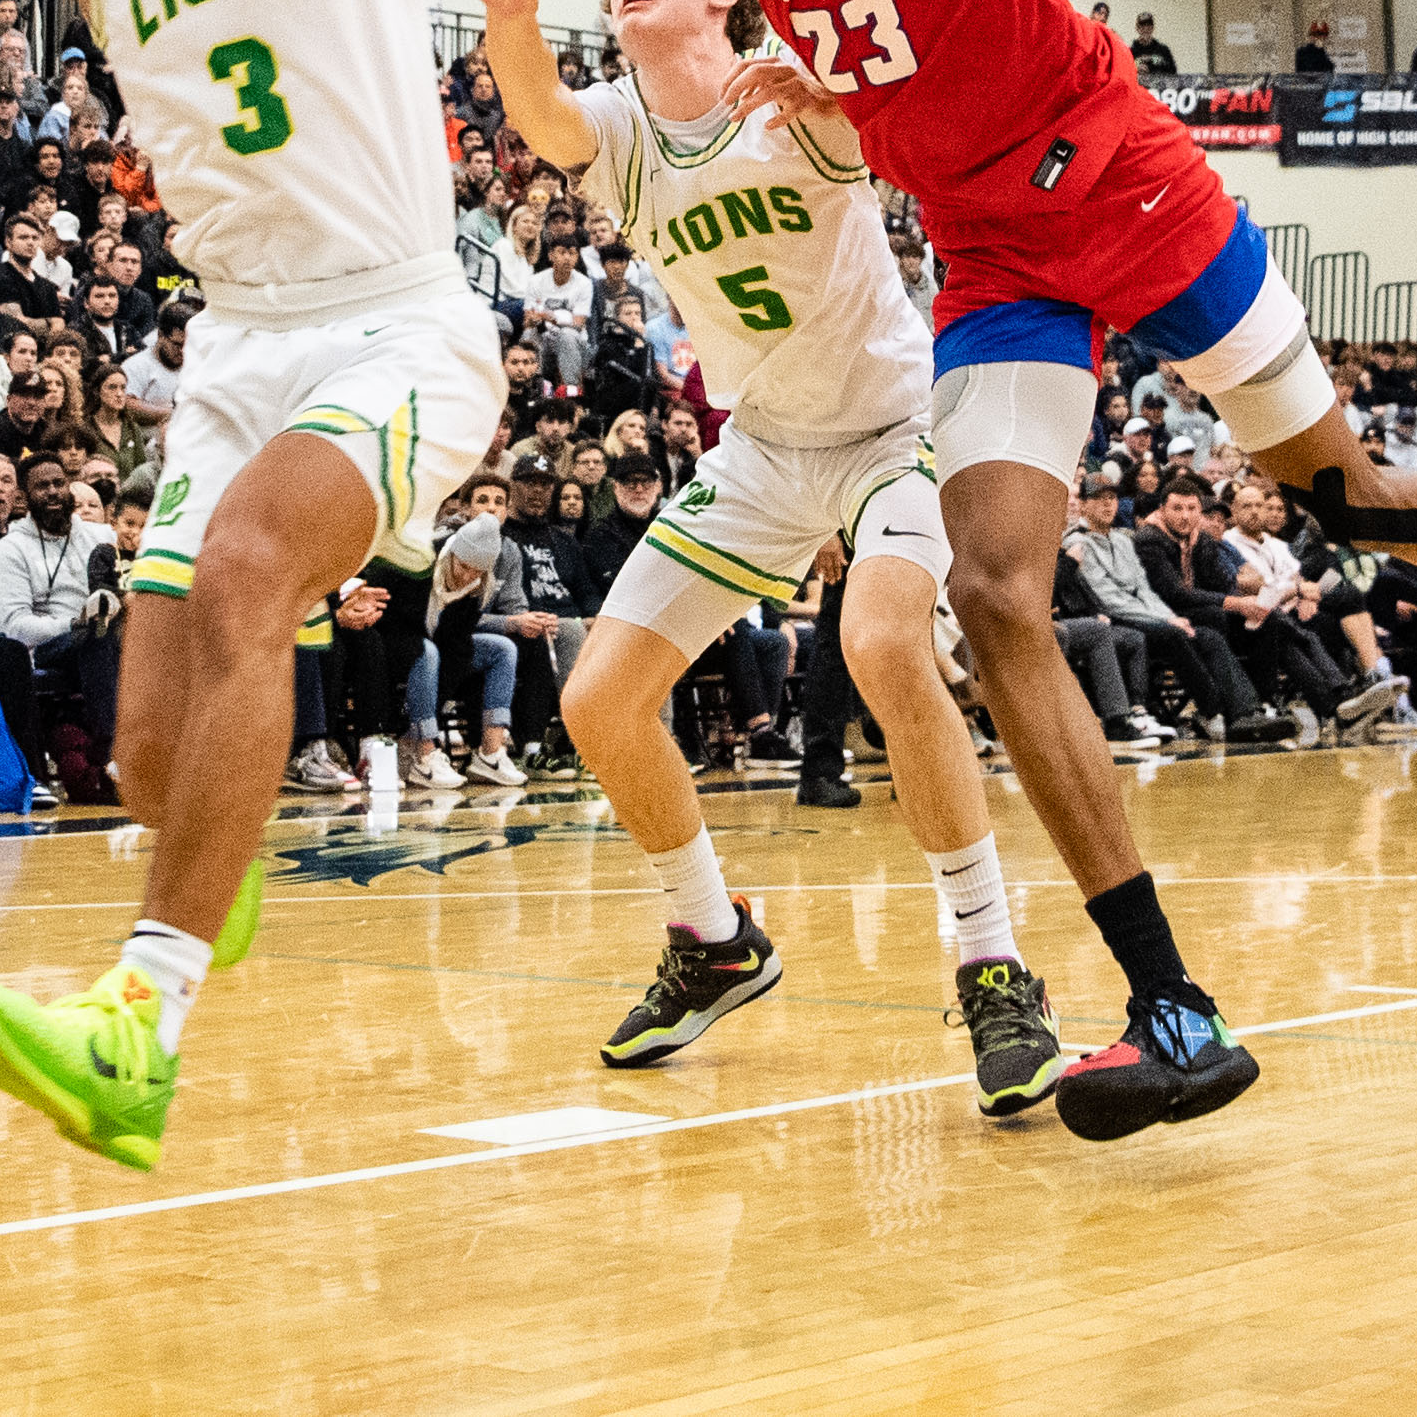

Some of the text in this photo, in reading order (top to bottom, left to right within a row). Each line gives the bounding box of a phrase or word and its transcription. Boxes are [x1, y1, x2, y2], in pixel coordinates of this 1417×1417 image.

[207, 35, 295, 156] 3
[1209, 88, 1274, 113] FAN
[1297, 130, 1335, 146] HOME
[1336, 130, 1354, 145] OF
[1356, 131, 1387, 146] HIGH
[651, 186, 814, 267] LIONS
[716, 265, 793, 332] 5
